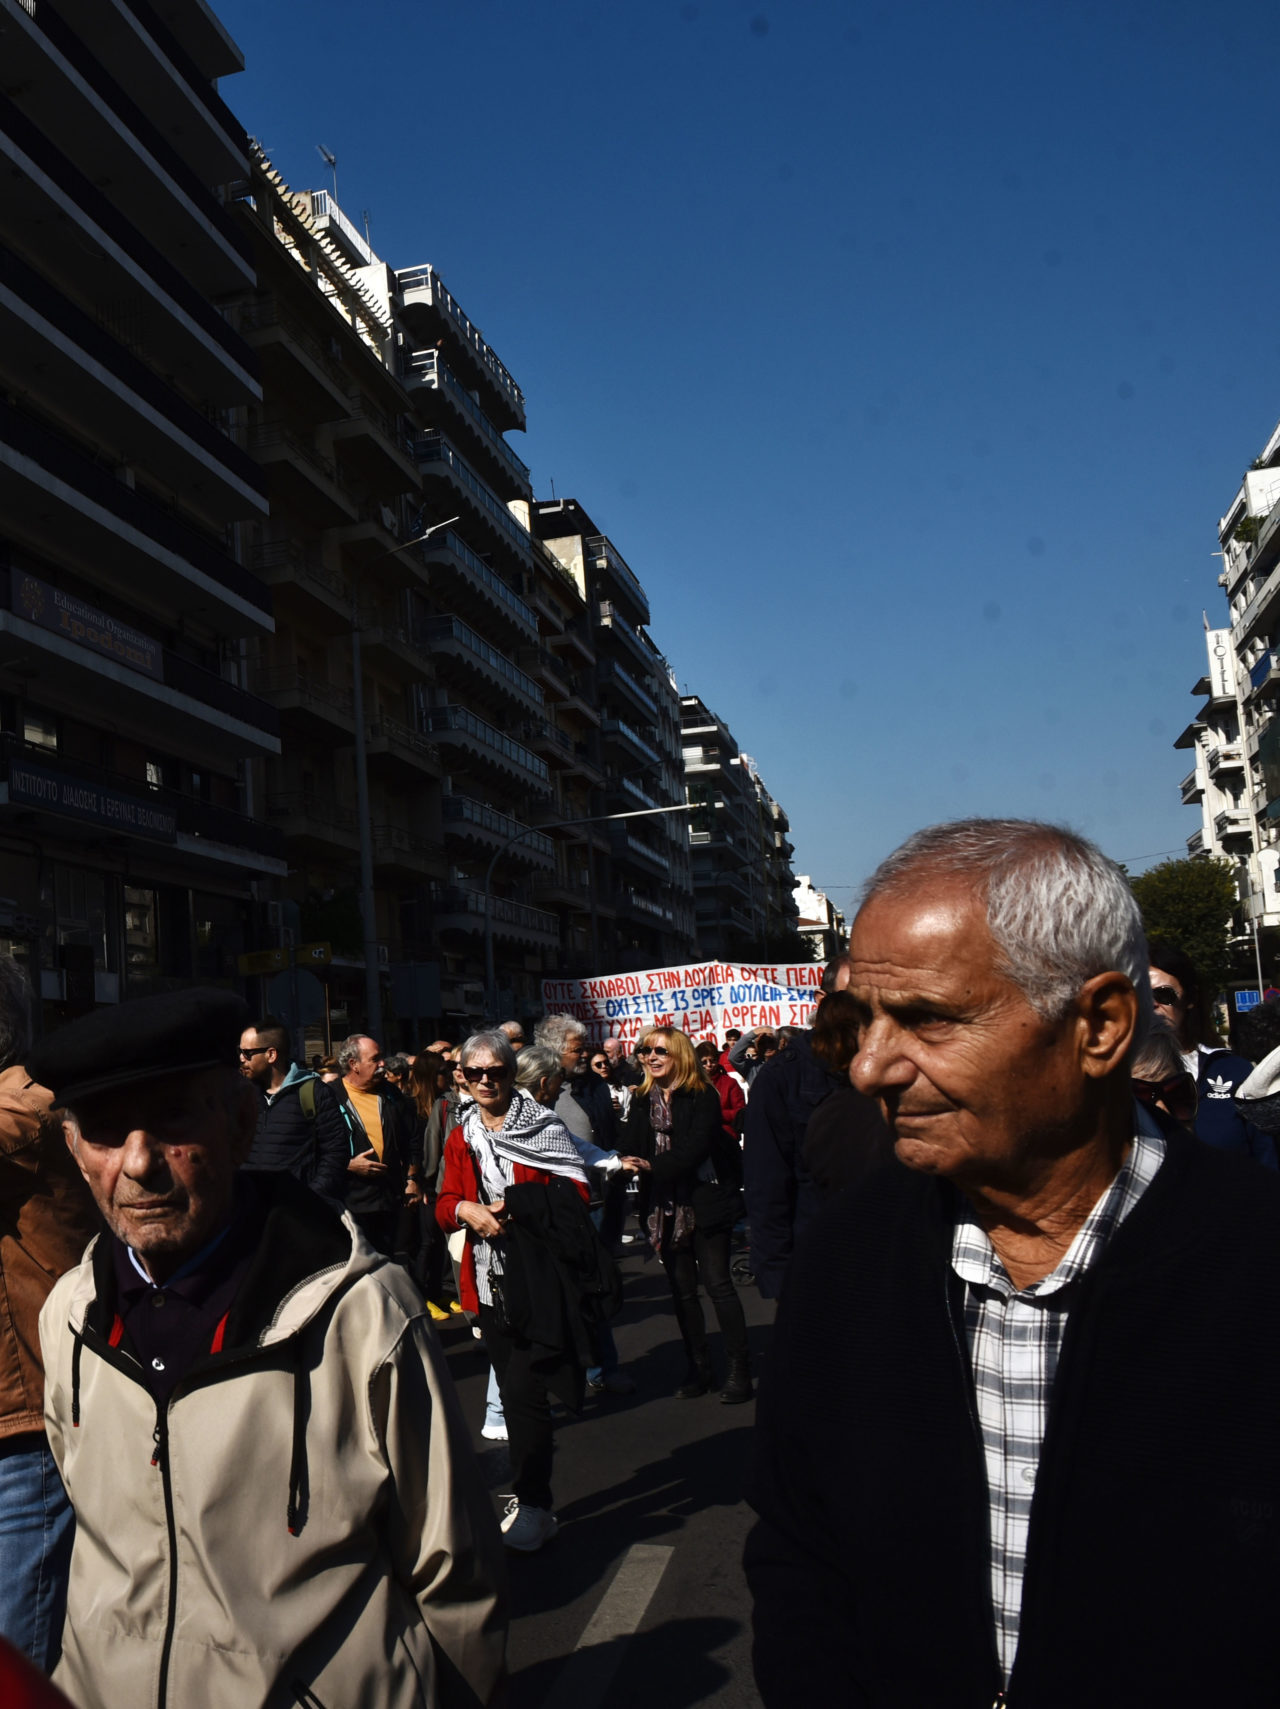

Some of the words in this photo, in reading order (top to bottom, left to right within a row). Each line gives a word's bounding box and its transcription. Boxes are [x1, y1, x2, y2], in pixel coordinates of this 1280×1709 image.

[54, 591, 106, 628] Educational
[107, 618, 156, 656] Organization
[60, 608, 153, 670] Ipodomi
[12, 768, 58, 801] ΙΝΣΤΙΤΟΥΤΟ
[62, 784, 98, 813] ΔΙΑΔΟΣΗΣ
[106, 798, 136, 825] ΕΡΕΥΝΑΣ
[543, 982, 576, 1000] ΟΥΤΕ
[580, 976, 641, 999] ΣΚΛΑΒΟΙ
[646, 969, 681, 992] ΣΤΗΝ
[684, 964, 735, 988] ΔΟΥΛΕΙΑ
[740, 967, 779, 985] ΟΥΤΕ
[606, 998, 630, 1018] ΟΧΙ
[632, 993, 668, 1014] ΣΤΙΣ
[671, 990, 690, 1011] 13
[692, 987, 725, 1009] ΩΡΕΣ
[654, 1013, 675, 1027] ΜΕ
[682, 1009, 716, 1033] ΑΞΙΑ
[722, 1005, 781, 1029] ΔΩΡΕΑΝ
[1206, 1092, 1231, 1100] adidas
